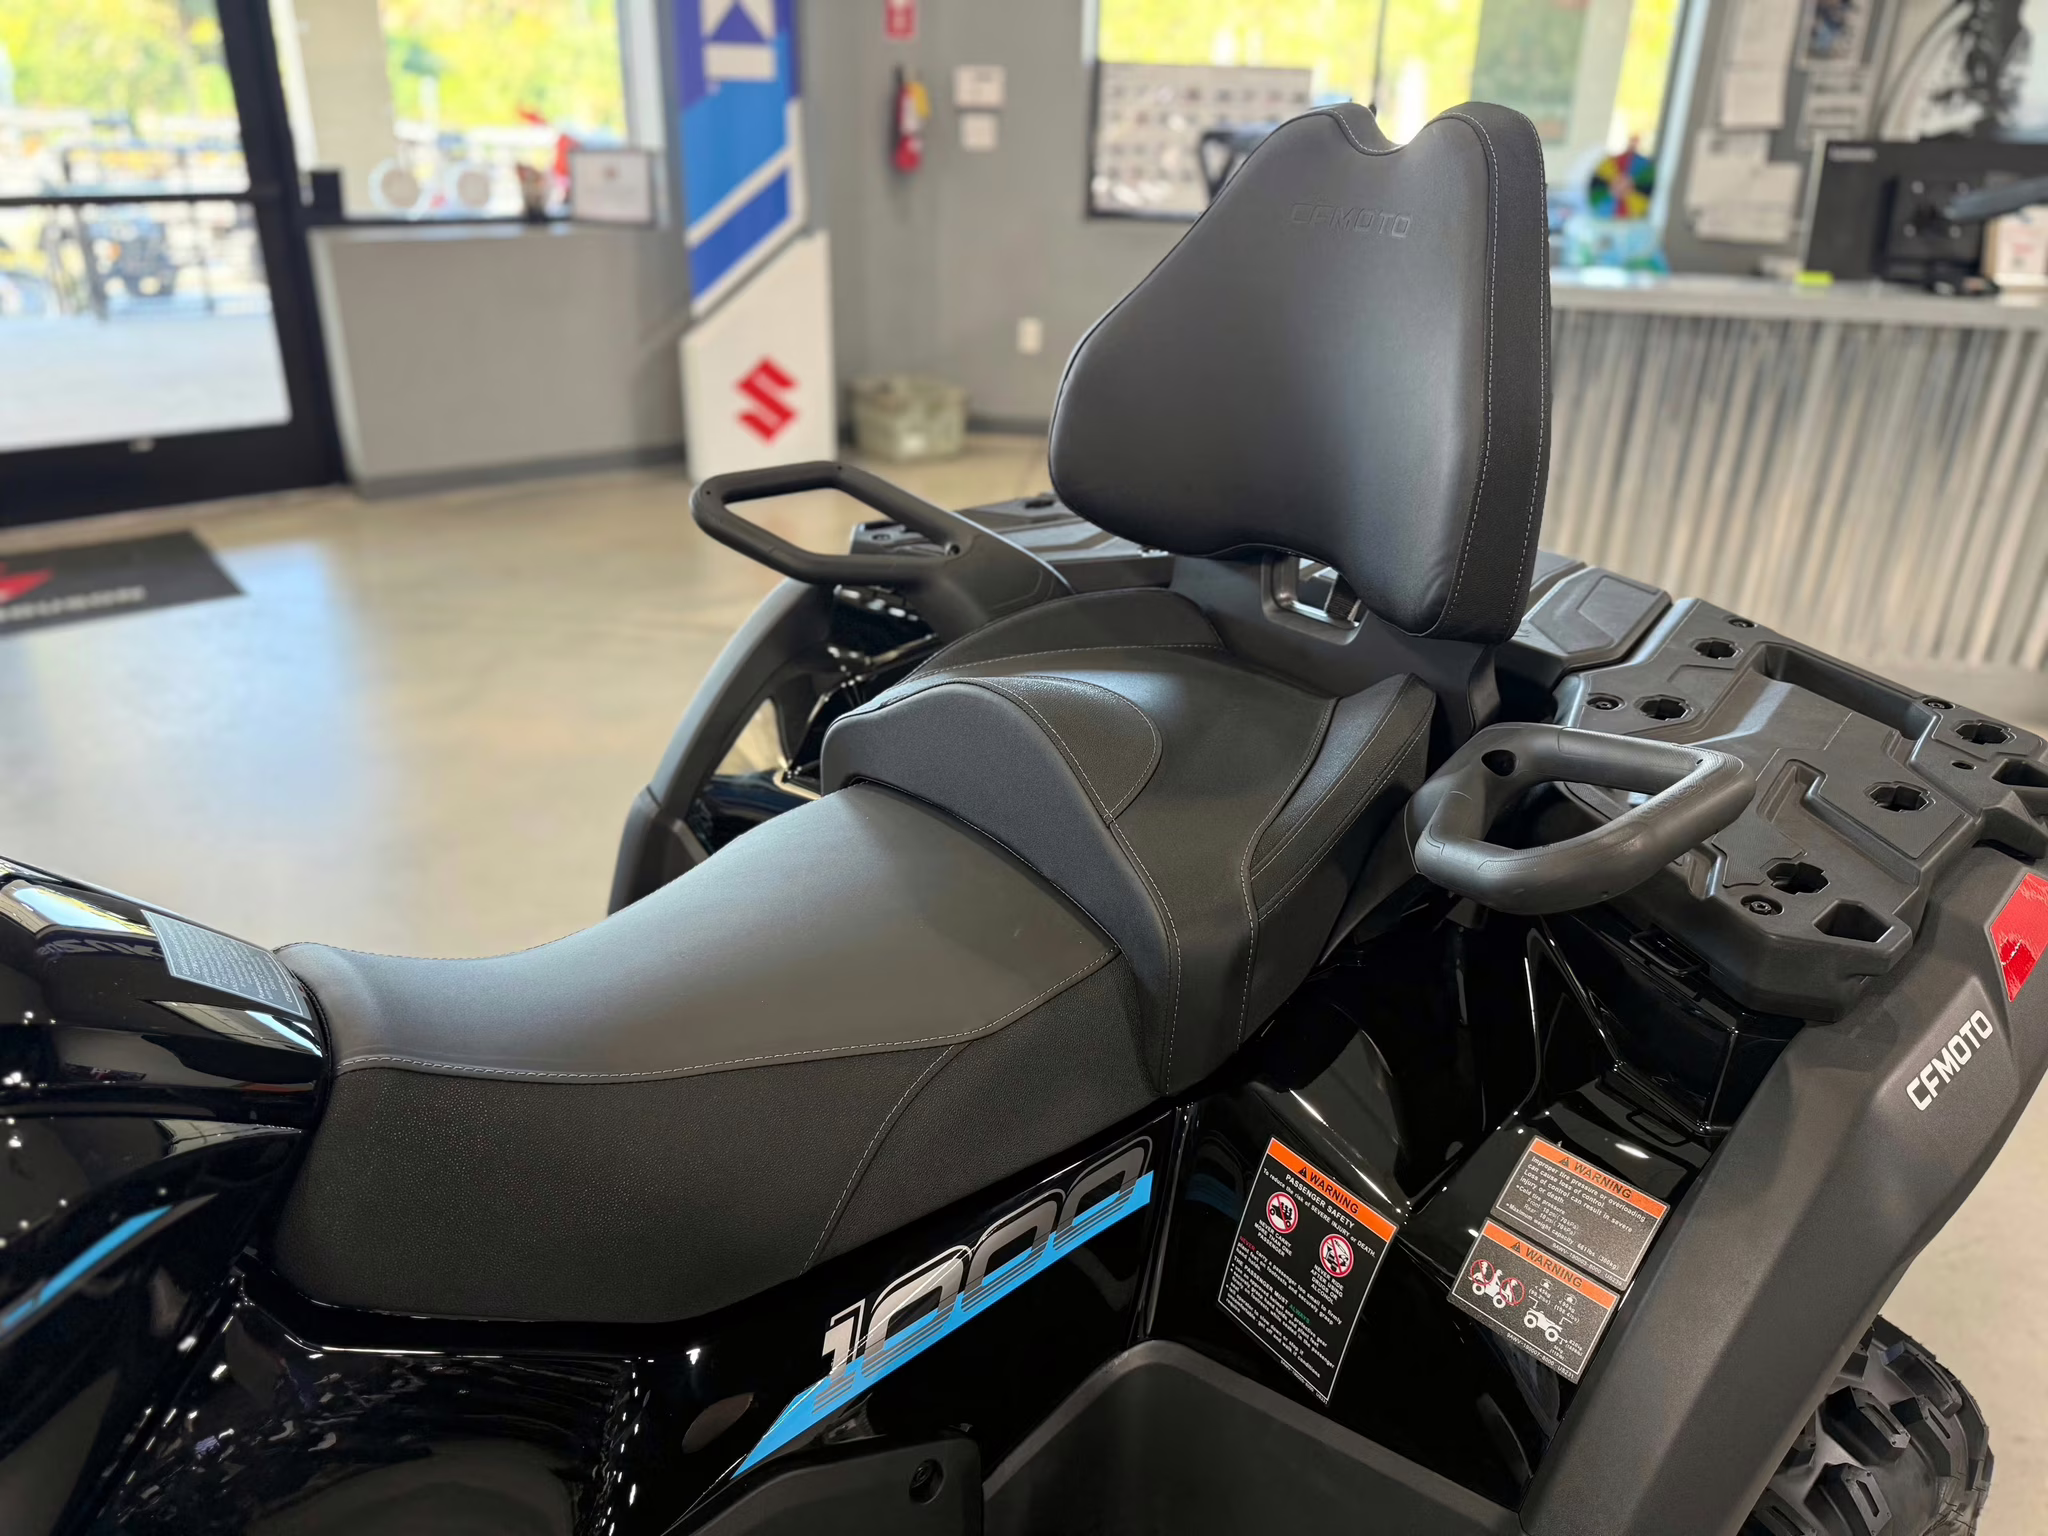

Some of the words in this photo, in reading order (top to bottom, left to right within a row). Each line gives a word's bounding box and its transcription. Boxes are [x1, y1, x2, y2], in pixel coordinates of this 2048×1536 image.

[1291, 202, 1411, 238] CFMOTO
[1906, 1010, 1993, 1111] CFMOTO
[1308, 1171, 1359, 1214] WARNING
[1518, 1175, 1538, 1190] injury
[1546, 1190, 1566, 1204] death.
[1527, 1163, 1539, 1172] can
[1539, 1169, 1558, 1182] cause
[1558, 1179, 1573, 1190] loss
[1572, 1186, 1581, 1195] of
[1530, 1155, 1558, 1175] Improper
[1558, 1170, 1571, 1180] tire
[1570, 1177, 1599, 1197] pressure
[1606, 1197, 1646, 1223] overloading
[1572, 1162, 1633, 1199] WARNING
[1262, 1167, 1269, 1176] To
[1269, 1172, 1285, 1188] reduce
[1285, 1184, 1294, 1195] the
[1294, 1191, 1304, 1202] risk
[1304, 1198, 1311, 1207] of
[1310, 1204, 1331, 1223] SEVERE
[1330, 1219, 1350, 1238] INJURY
[1349, 1235, 1357, 1243] or
[1356, 1239, 1376, 1258] DEATH.
[1285, 1173, 1326, 1208] PASSENGER
[1326, 1204, 1354, 1230] SAFETY
[1518, 1185, 1532, 1196] Cold
[1531, 1192, 1542, 1201] tire
[1541, 1199, 1565, 1215] pressure
[1523, 1168, 1539, 1180] Loss
[1539, 1177, 1547, 1185] of
[1547, 1182, 1570, 1198] control
[1569, 1195, 1582, 1204] can
[1582, 1201, 1602, 1216] result
[1602, 1212, 1610, 1220] in
[1610, 1217, 1633, 1233] severe
[1253, 1221, 1268, 1236] MORE
[1268, 1233, 1281, 1247] THAN
[1281, 1244, 1292, 1256] ONE
[1258, 1218, 1274, 1235] NEVER
[1274, 1231, 1291, 1248] CARRY
[1531, 1217, 1551, 1232] weight
[1257, 1231, 1285, 1257] PASSENGER
[813, 1136, 1152, 1414] 1000
[1233, 1254, 1243, 1266] THE
[1243, 1264, 1273, 1292] PASSENGER
[1273, 1289, 1288, 1305] MUST
[1237, 1240, 1249, 1254] plant
[1259, 1259, 1266, 1268] on
[1266, 1264, 1288, 1286] footrests
[1287, 1283, 1298, 1295] and
[1297, 1292, 1318, 1313] securely
[1318, 1310, 1333, 1326] grasp
[1309, 1267, 1327, 1284] AFTER
[1326, 1281, 1343, 1298] USING
[1313, 1263, 1331, 1280] NEVER
[1330, 1277, 1344, 1291] RIDE
[1523, 1247, 1584, 1288] WARNING
[1255, 1249, 1267, 1263] carry
[1272, 1263, 1296, 1288] passenger
[1297, 1283, 1306, 1294] too
[1306, 1291, 1320, 1306] small
[1320, 1303, 1327, 1312] to
[1326, 1308, 1342, 1326] firmly
[1310, 1282, 1334, 1305] ALCOHOL
[1311, 1275, 1329, 1293] DRUGS
[1329, 1290, 1338, 1301] OR
[1284, 1308, 1293, 1318] and
[1293, 1315, 1316, 1339] protective
